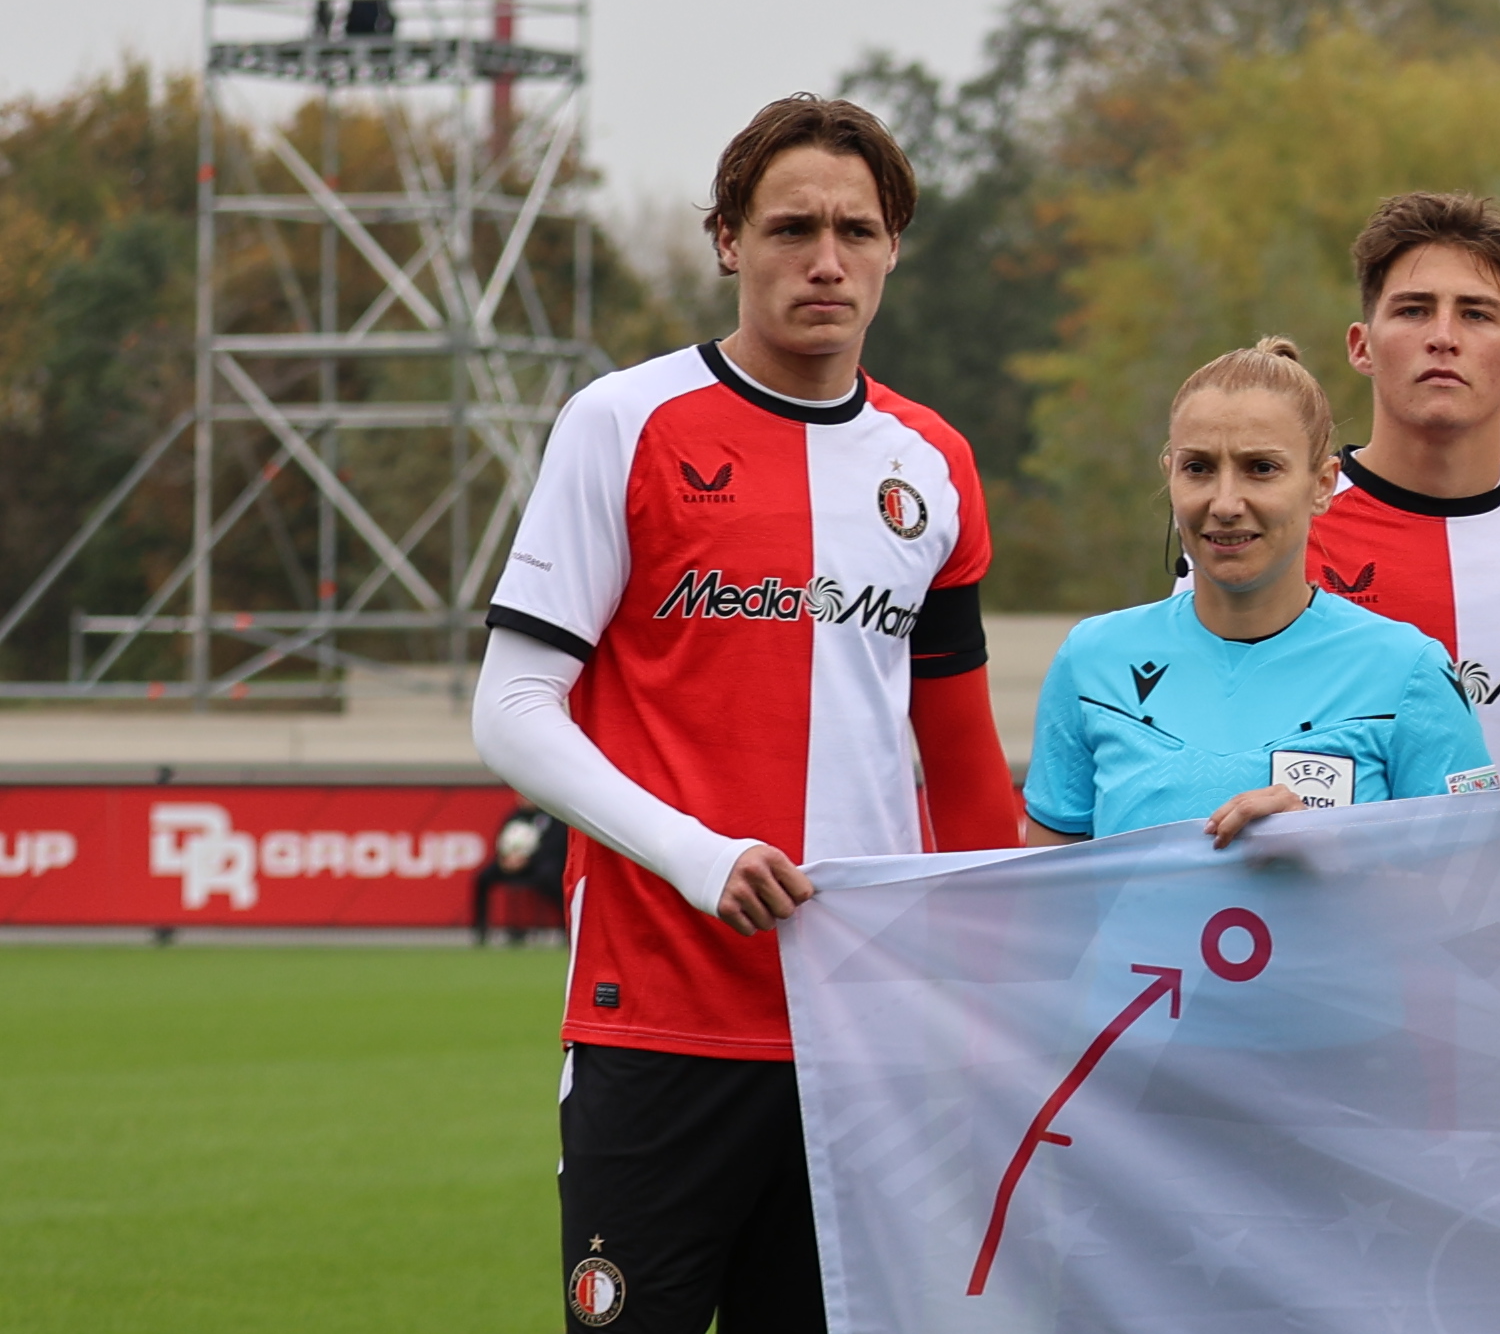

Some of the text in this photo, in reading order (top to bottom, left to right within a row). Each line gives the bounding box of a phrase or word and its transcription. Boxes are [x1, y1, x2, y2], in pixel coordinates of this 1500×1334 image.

[653, 569, 804, 621] Media
[1287, 764, 1337, 785] UEFA
[1303, 796, 1335, 808] ATCH
[259, 830, 488, 878] GROUP
